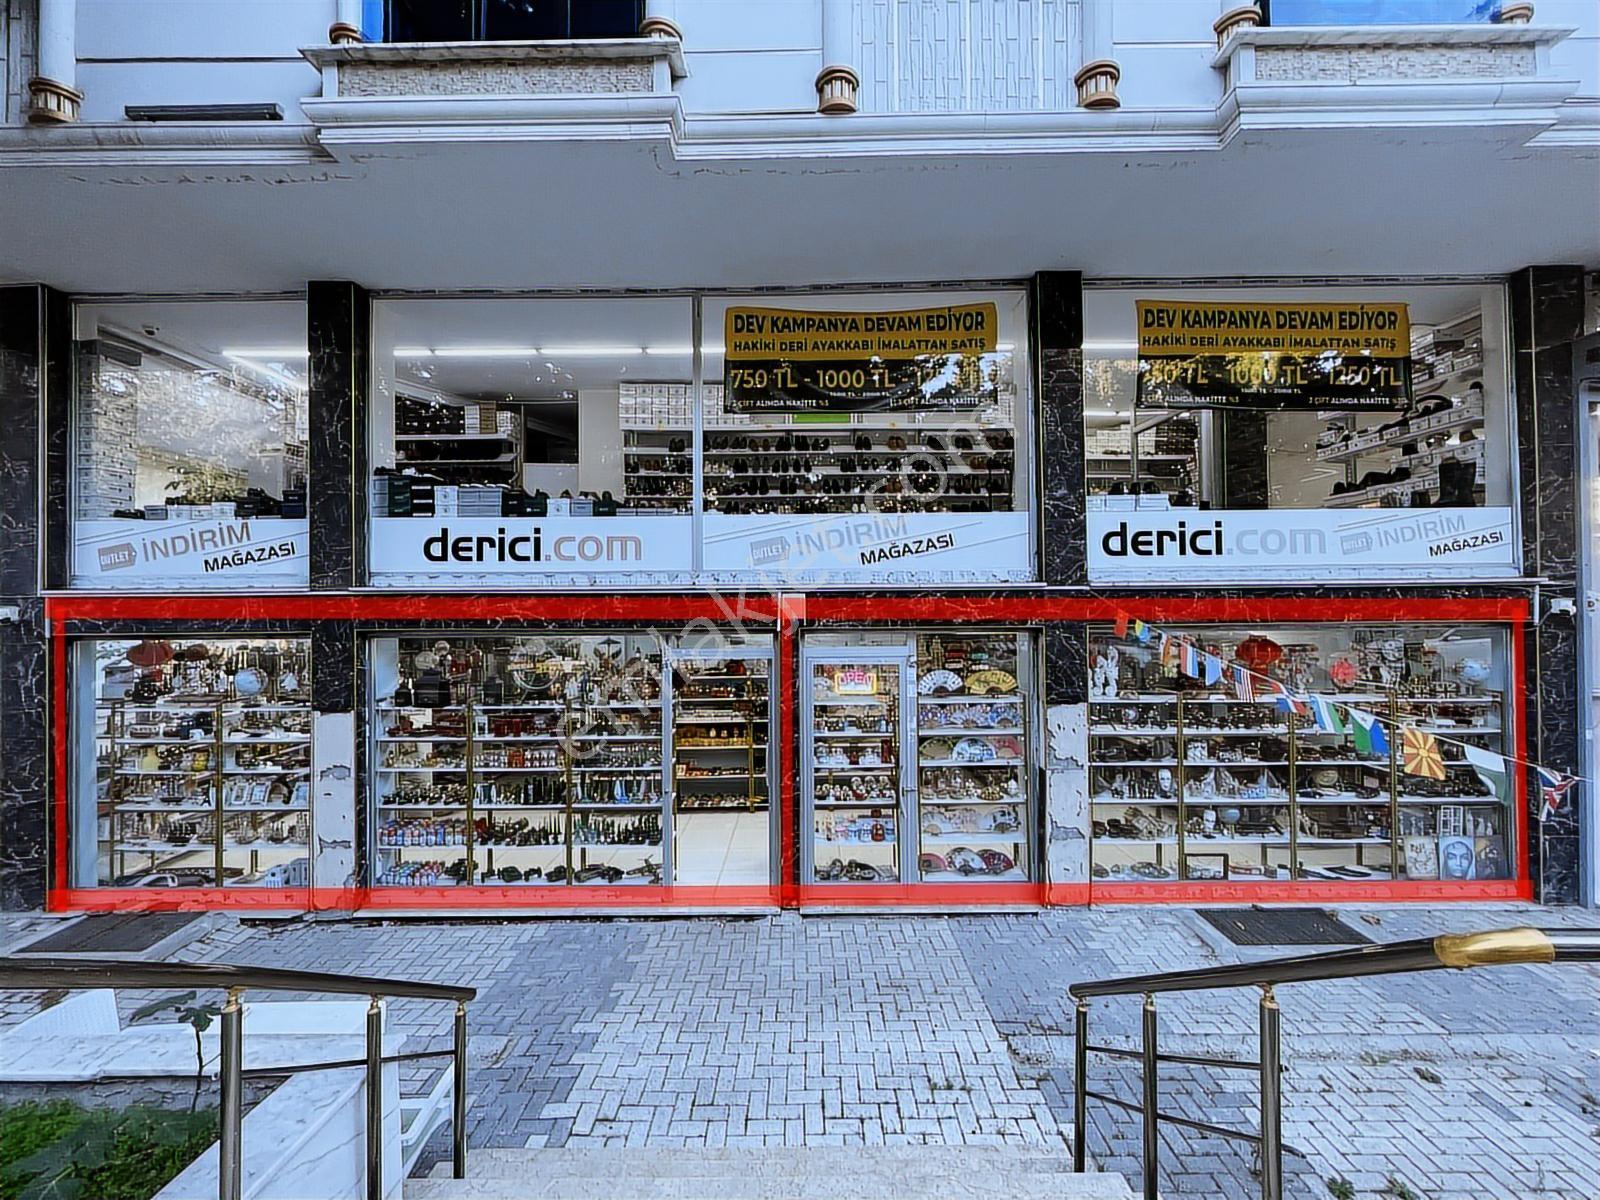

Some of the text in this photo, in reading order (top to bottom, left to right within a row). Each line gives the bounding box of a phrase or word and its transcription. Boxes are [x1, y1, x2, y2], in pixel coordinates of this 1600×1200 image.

[733, 308, 985, 334] DEV KAMPANYA DEVAM EDİYOR
[1143, 305, 1398, 330] DEV KAMPANYA DEVAM EDİYOR
[734, 337, 986, 352] HAKİKİ DERİ AYAKKABI İMALATTAN SATIŞ
[1143, 333, 1396, 350] HAKİKİ DERİ AYAKKABI İMALATTAN SATIŞ
[730, 369, 768, 388] 750
[773, 368, 798, 388] TL
[816, 369, 865, 388] 1000
[870, 369, 896, 388] TL
[1282, 366, 1308, 385] TL
[1380, 366, 1403, 387] TL
[142, 521, 251, 562] İNDİRİM
[423, 527, 642, 562] derici.com
[796, 515, 908, 556] İNDİRİM
[1102, 520, 1326, 557] derici.com
[1376, 514, 1466, 548] İNDİRİM
[1429, 530, 1504, 558] MAĞAZASI
[203, 541, 296, 573] MAĞAZASI
[860, 533, 954, 565] MAĞAZASI
